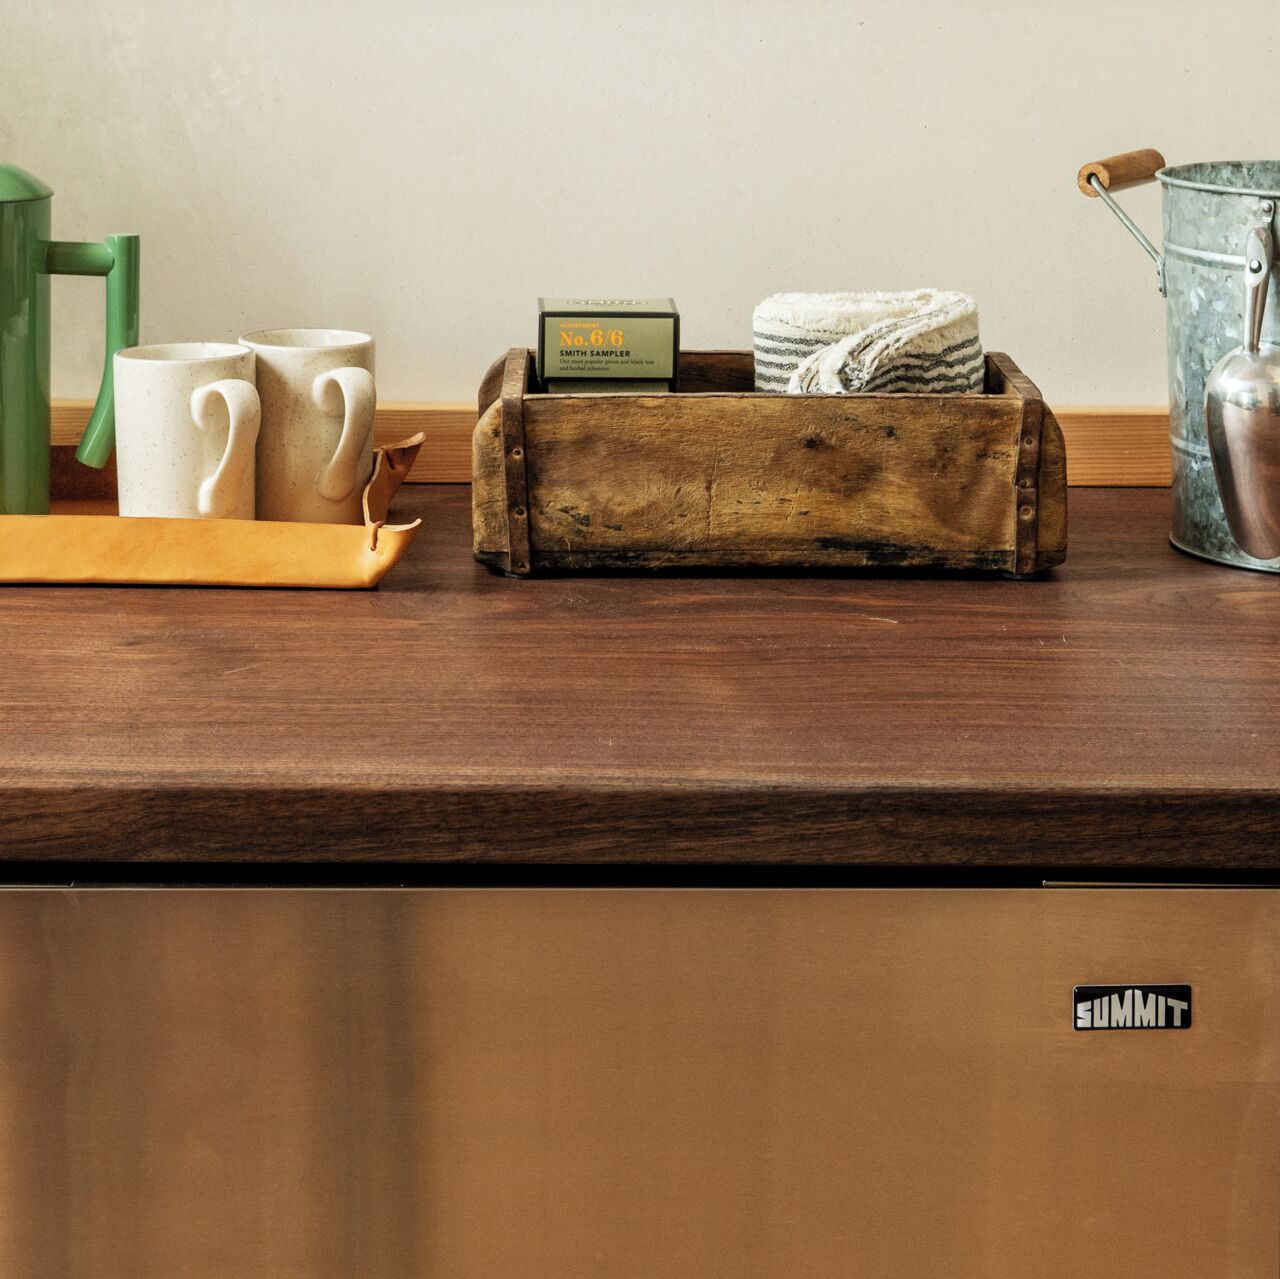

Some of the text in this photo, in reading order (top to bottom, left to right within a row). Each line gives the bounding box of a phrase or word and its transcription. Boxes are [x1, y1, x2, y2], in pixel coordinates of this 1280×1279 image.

[559, 349, 631, 358] SMITH SAMPLER
[1076, 988, 1189, 1028] SUMMIT
